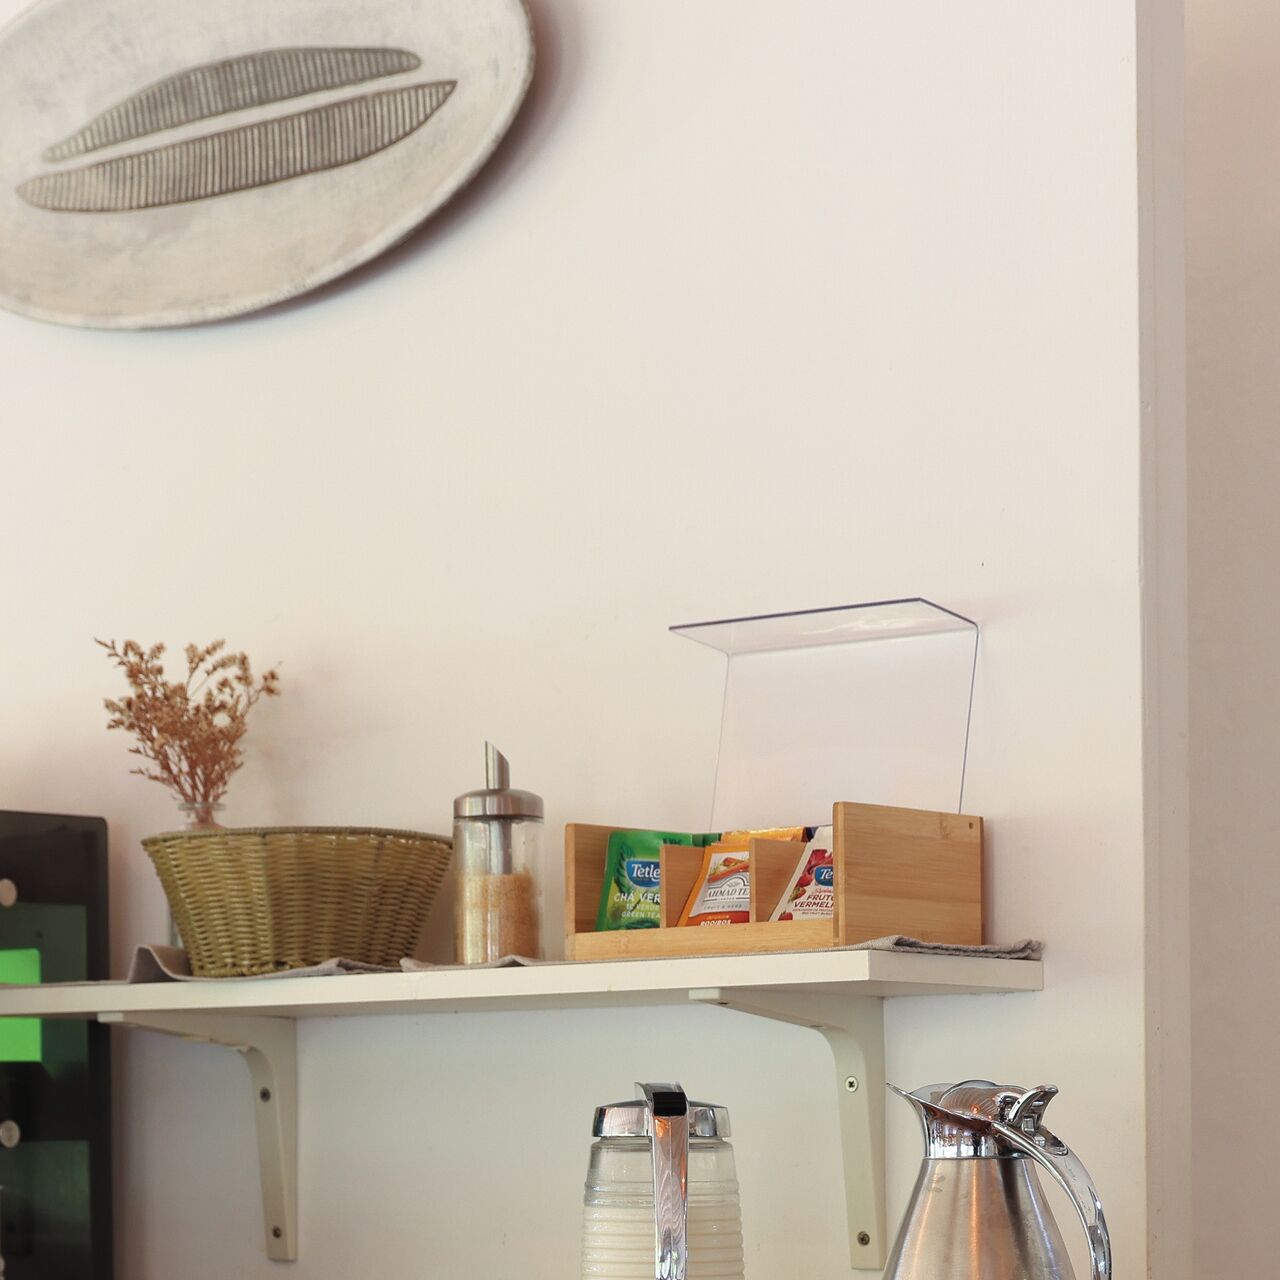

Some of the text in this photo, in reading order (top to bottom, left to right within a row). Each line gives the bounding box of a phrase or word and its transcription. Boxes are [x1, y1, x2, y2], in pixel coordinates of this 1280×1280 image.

[632, 864, 660, 882] Tetle
[708, 887, 749, 897] AHMAD TE
[640, 893, 660, 903] VER
[807, 894, 833, 902] FRUT
[794, 901, 833, 909] VERMEL
